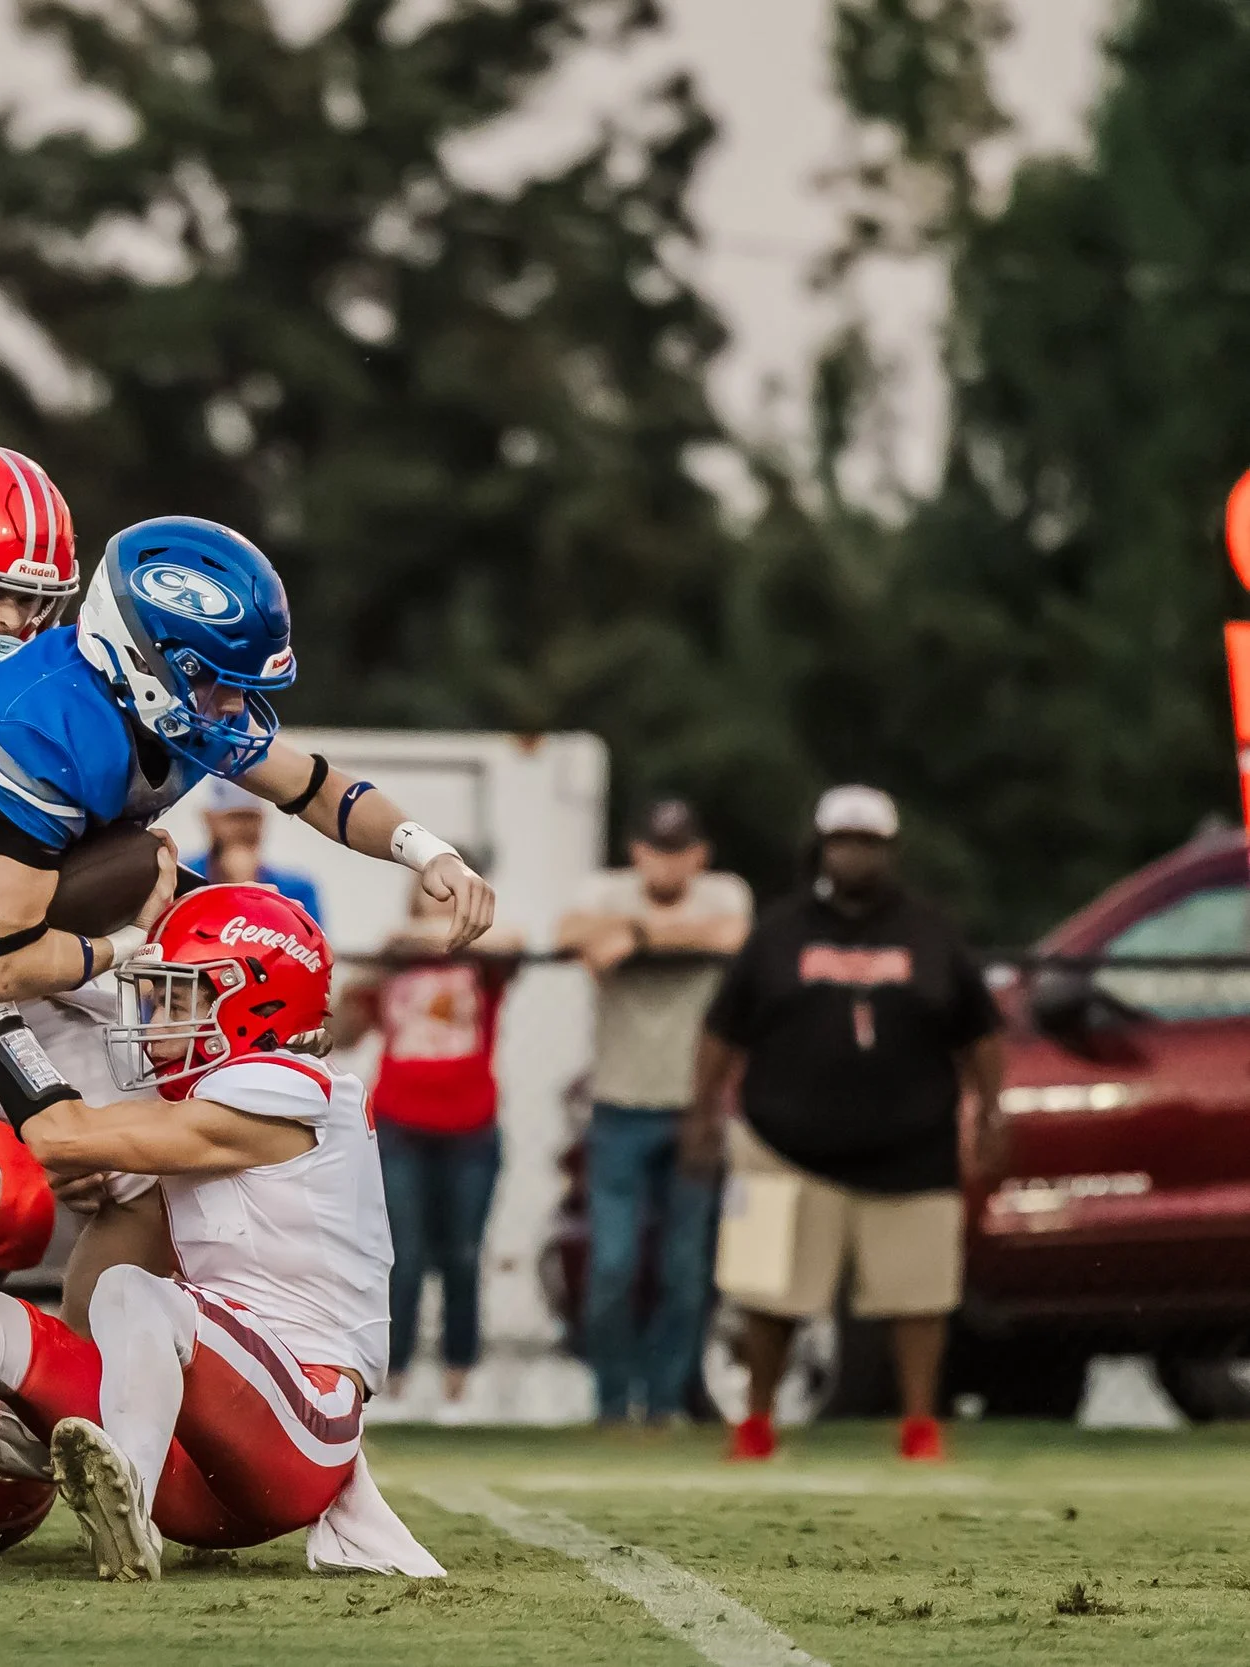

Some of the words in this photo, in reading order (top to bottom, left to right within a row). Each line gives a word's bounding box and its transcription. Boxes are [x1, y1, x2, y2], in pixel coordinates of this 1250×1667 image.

[18, 563, 56, 579] Riddell
[152, 568, 211, 614] CA
[219, 915, 322, 974] Generals
